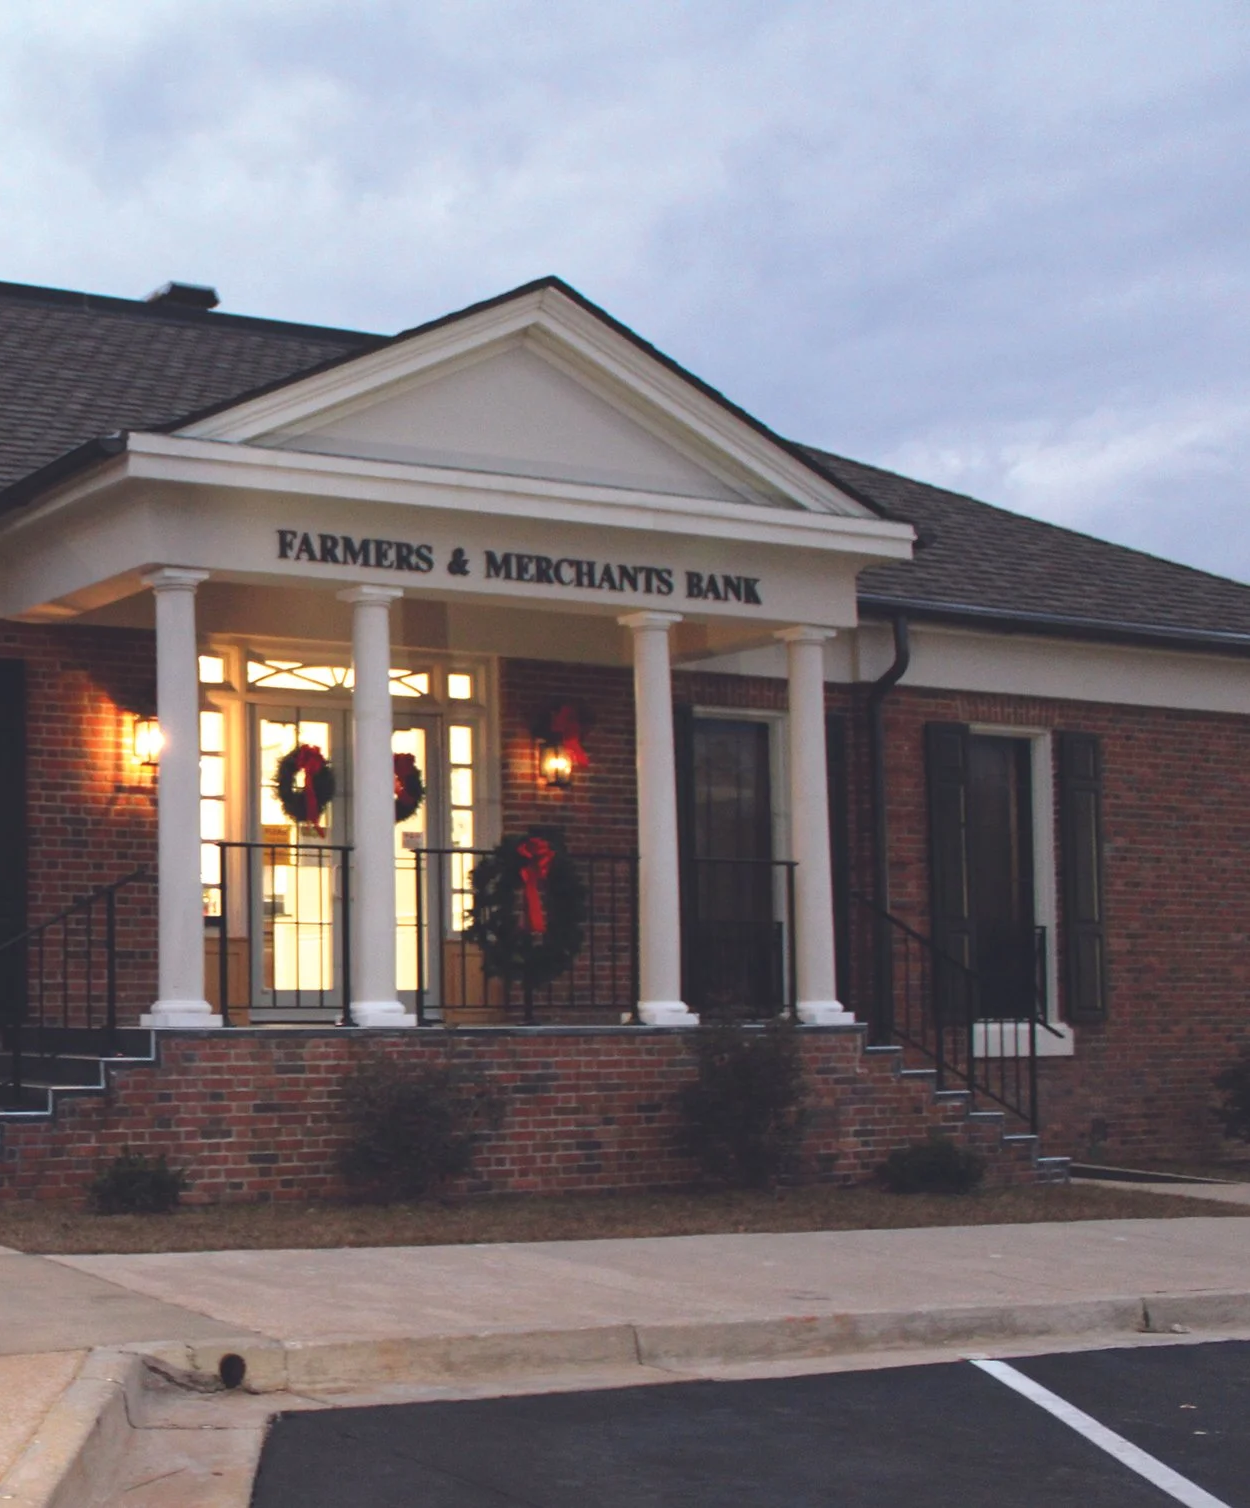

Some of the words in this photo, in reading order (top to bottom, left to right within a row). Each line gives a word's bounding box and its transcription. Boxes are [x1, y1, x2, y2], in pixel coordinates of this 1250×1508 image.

[277, 530, 435, 573] FARMERS
[447, 548, 470, 577] &
[484, 550, 674, 596] MERCHANTS
[684, 571, 763, 605] BANK
